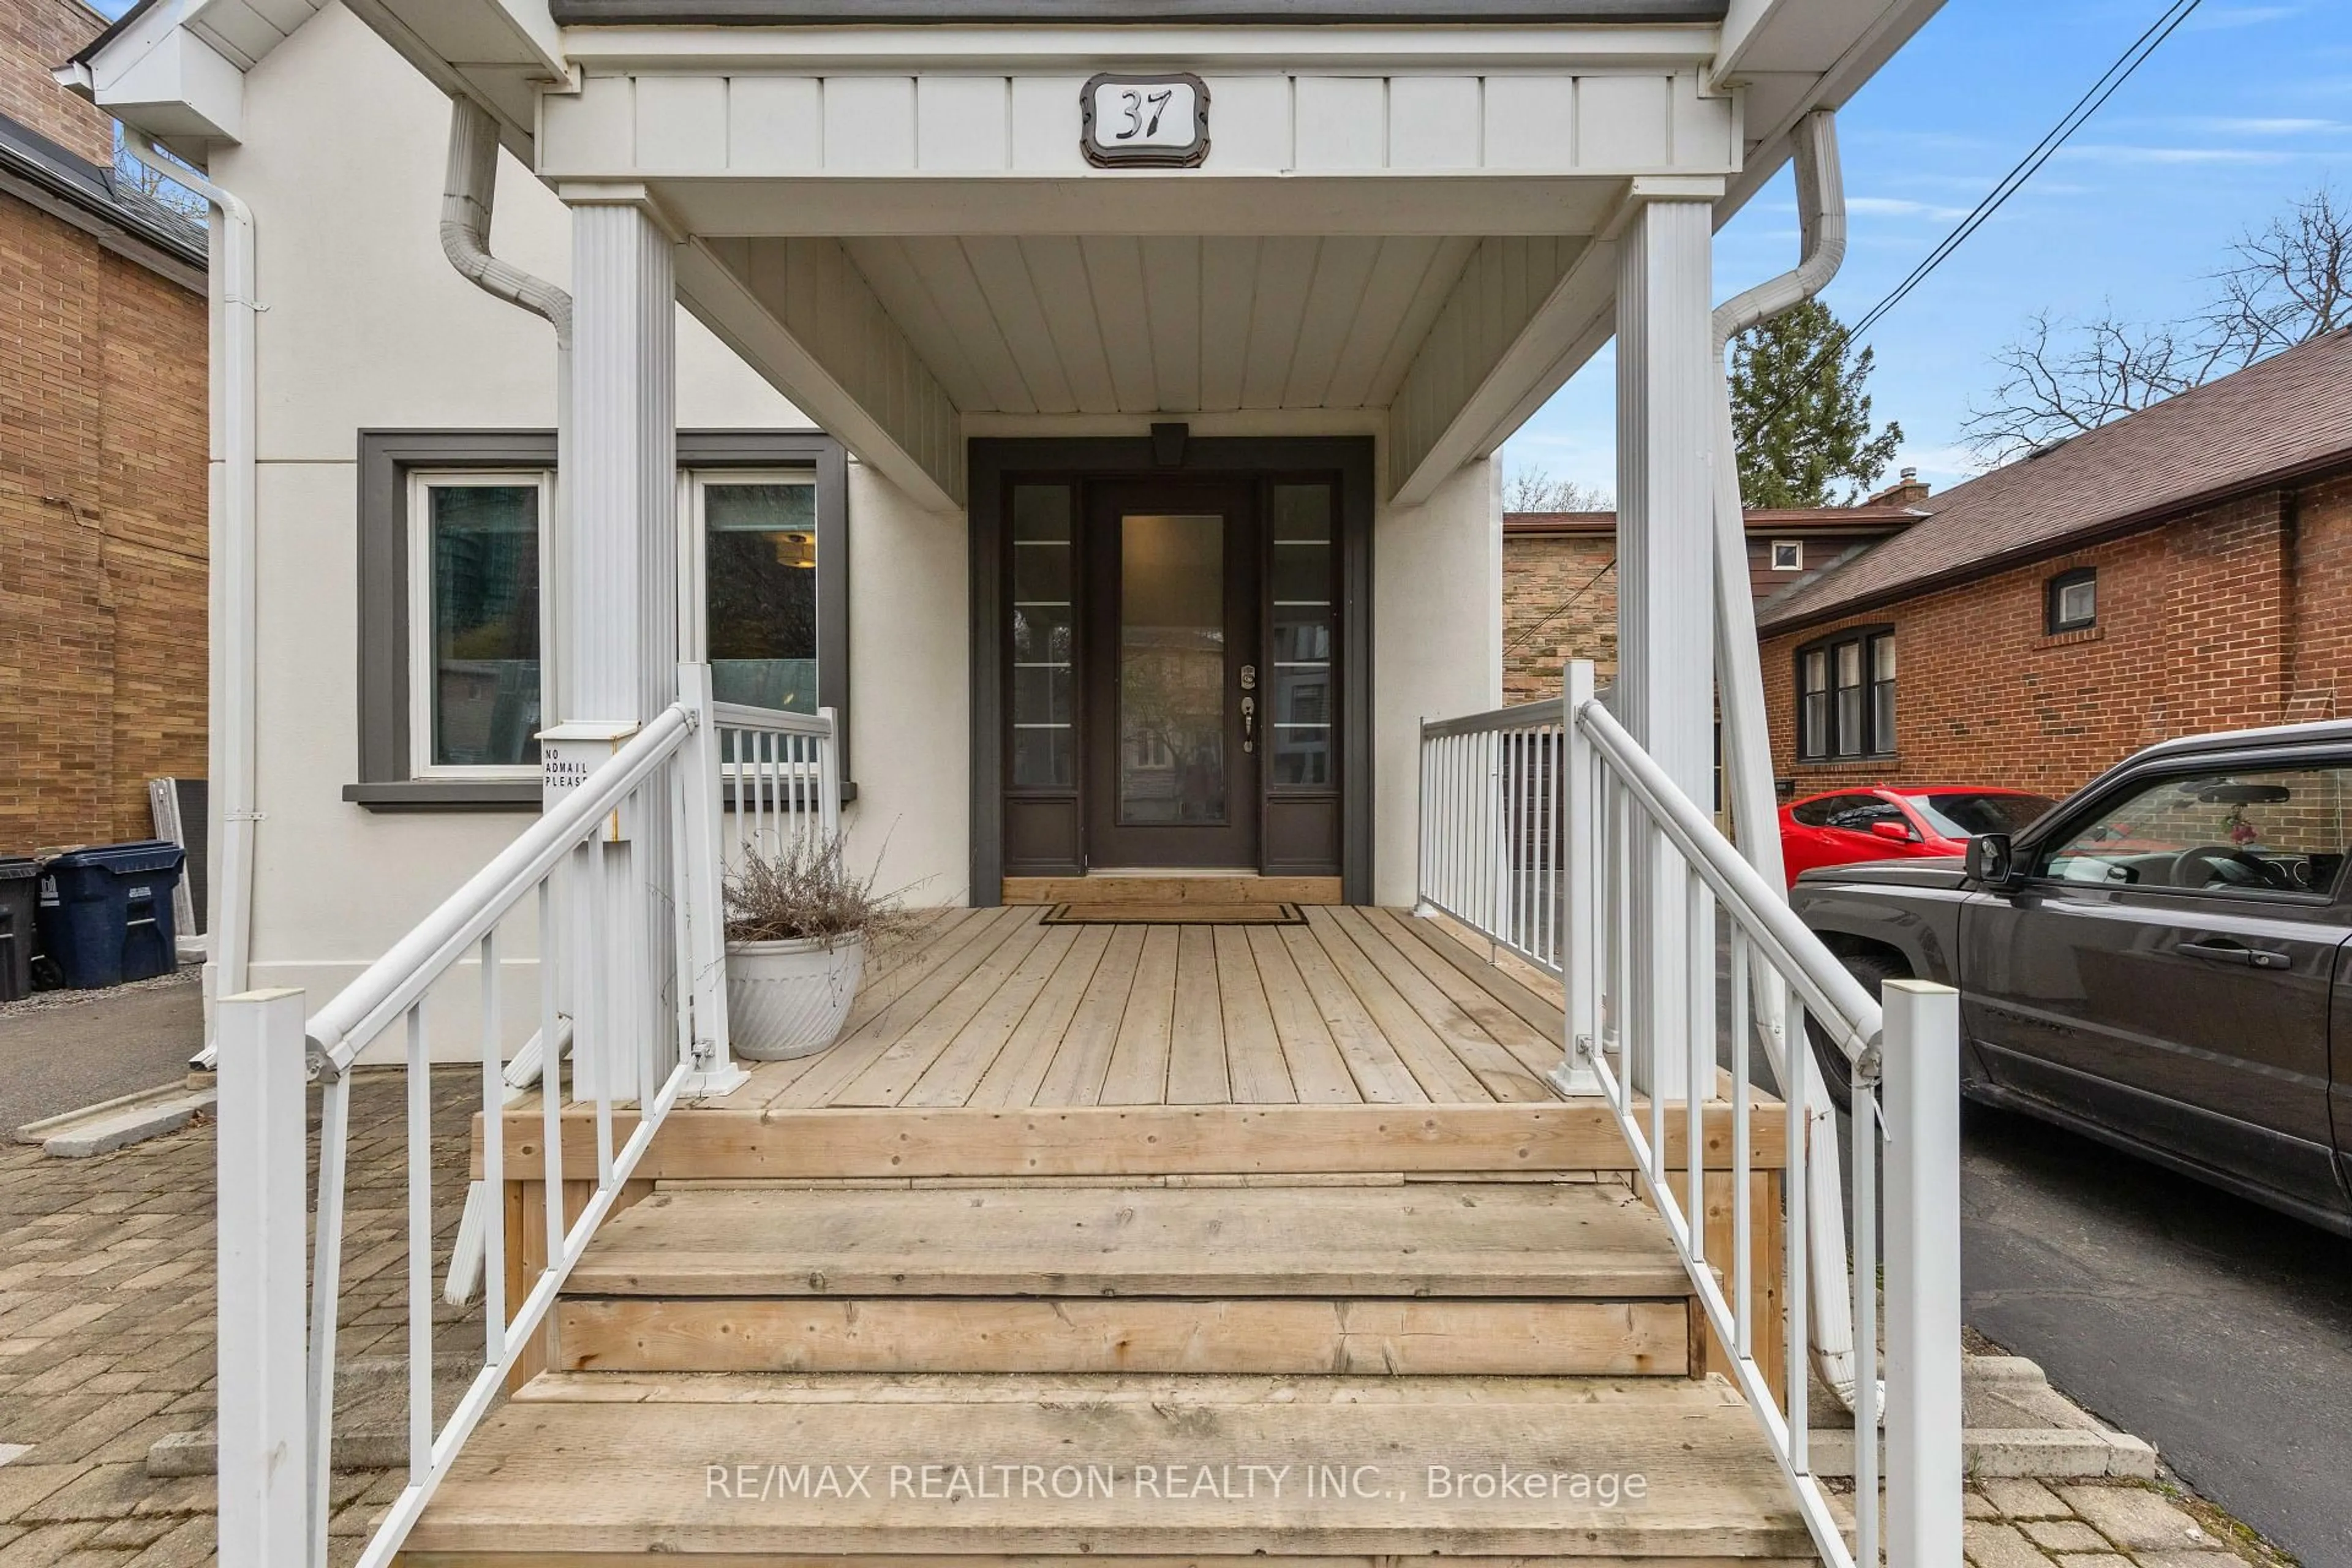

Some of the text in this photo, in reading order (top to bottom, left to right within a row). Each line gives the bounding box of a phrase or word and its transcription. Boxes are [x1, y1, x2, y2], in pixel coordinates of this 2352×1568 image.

[1116, 89, 1172, 139] 37
[546, 749, 559, 760] NO
[546, 763, 587, 773] ADMAIL
